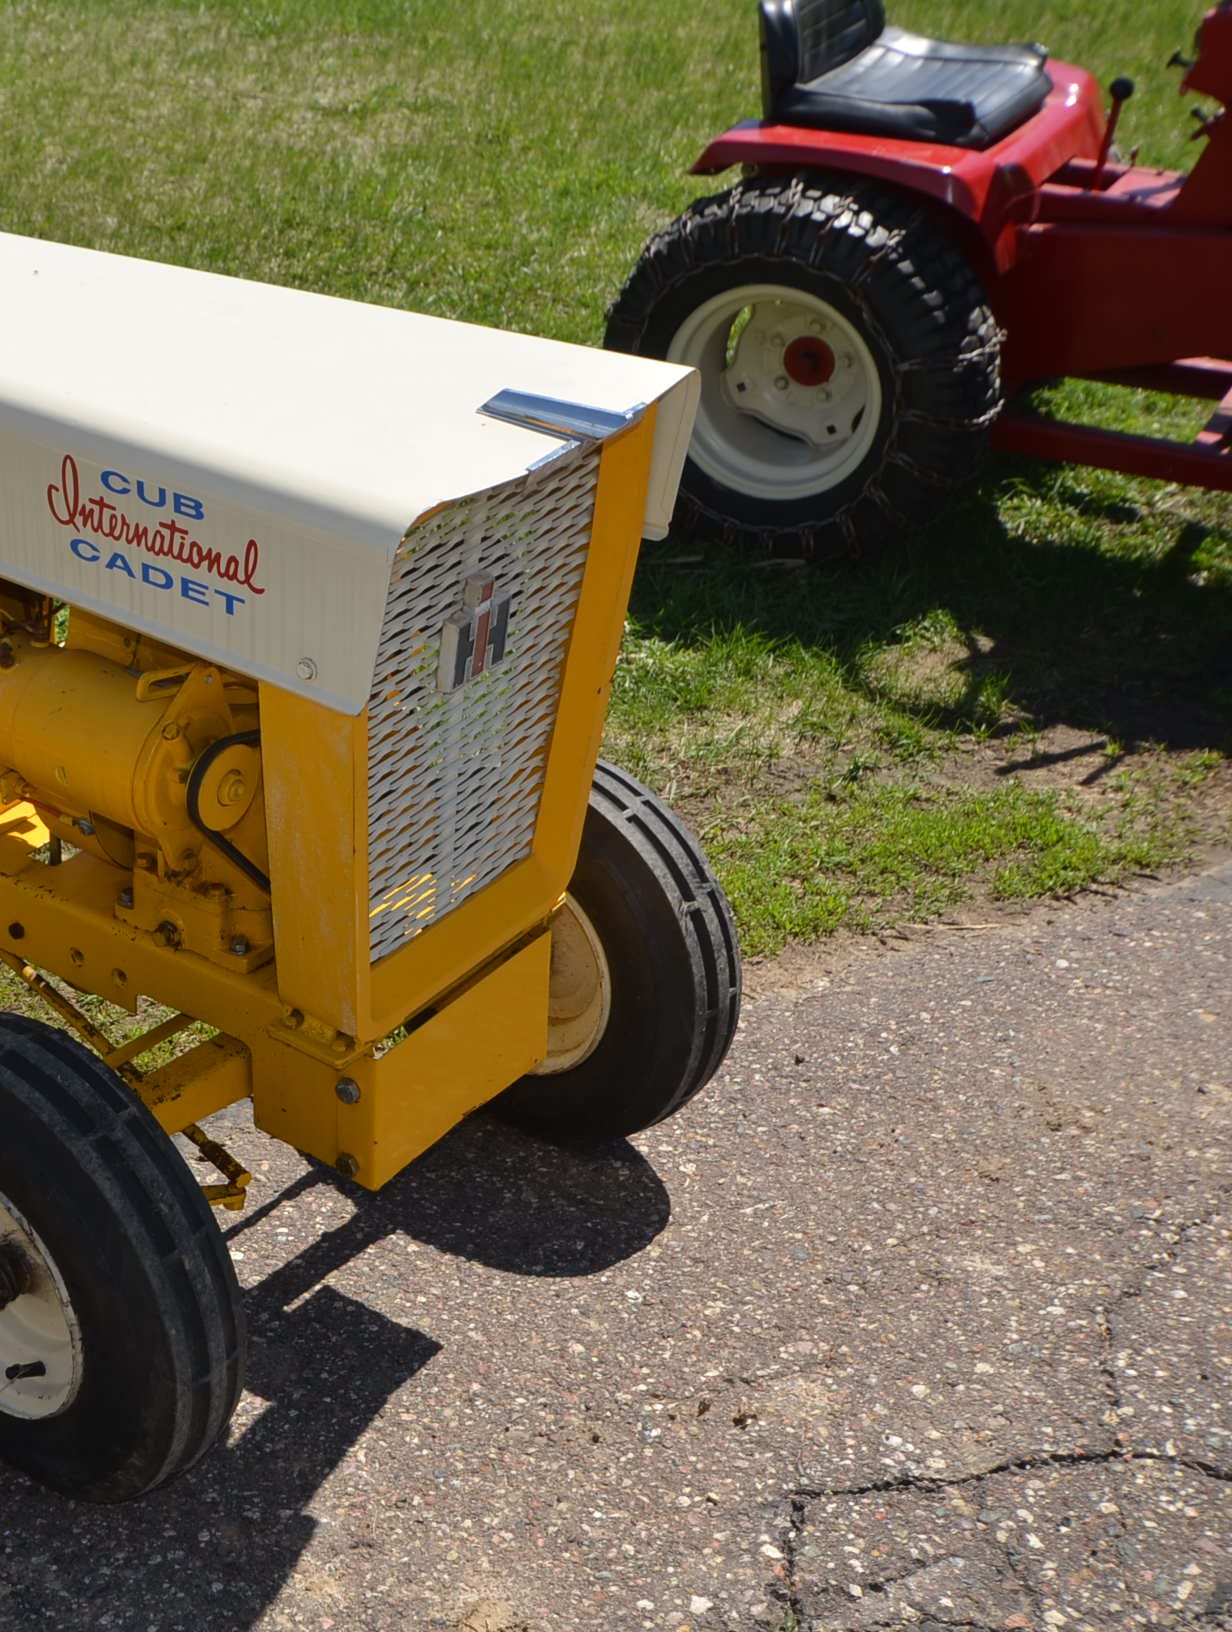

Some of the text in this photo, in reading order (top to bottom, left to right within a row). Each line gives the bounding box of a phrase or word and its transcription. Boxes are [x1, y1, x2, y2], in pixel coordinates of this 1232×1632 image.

[47, 454, 265, 594] International
[100, 470, 205, 520] CUB
[69, 538, 246, 616] CADET
